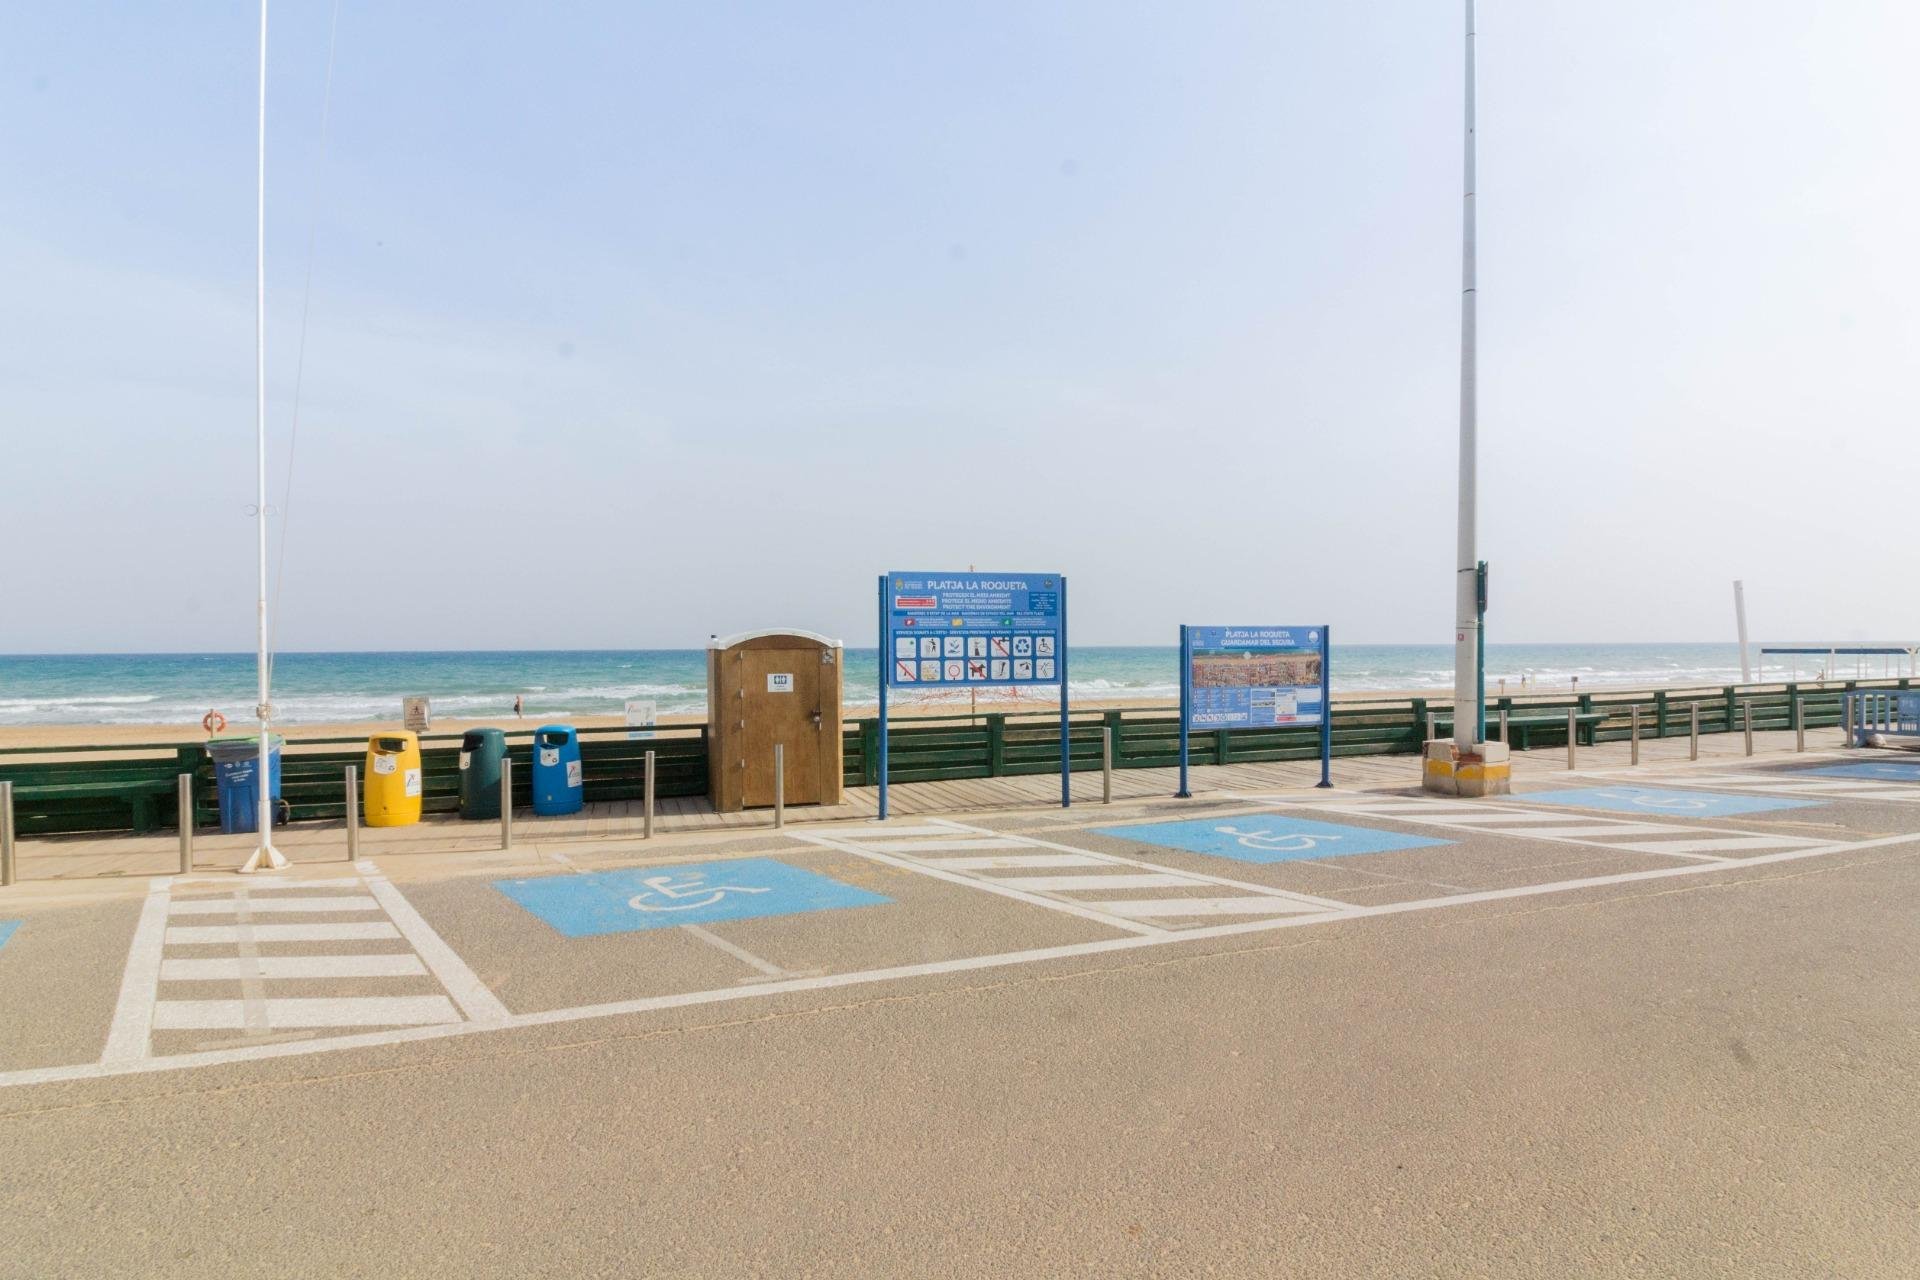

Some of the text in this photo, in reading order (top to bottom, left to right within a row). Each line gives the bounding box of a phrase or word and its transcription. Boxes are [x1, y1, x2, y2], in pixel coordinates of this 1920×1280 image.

[927, 580, 964, 590] PLATJA
[966, 580, 978, 590] LA
[981, 580, 1028, 590] ROQUETA
